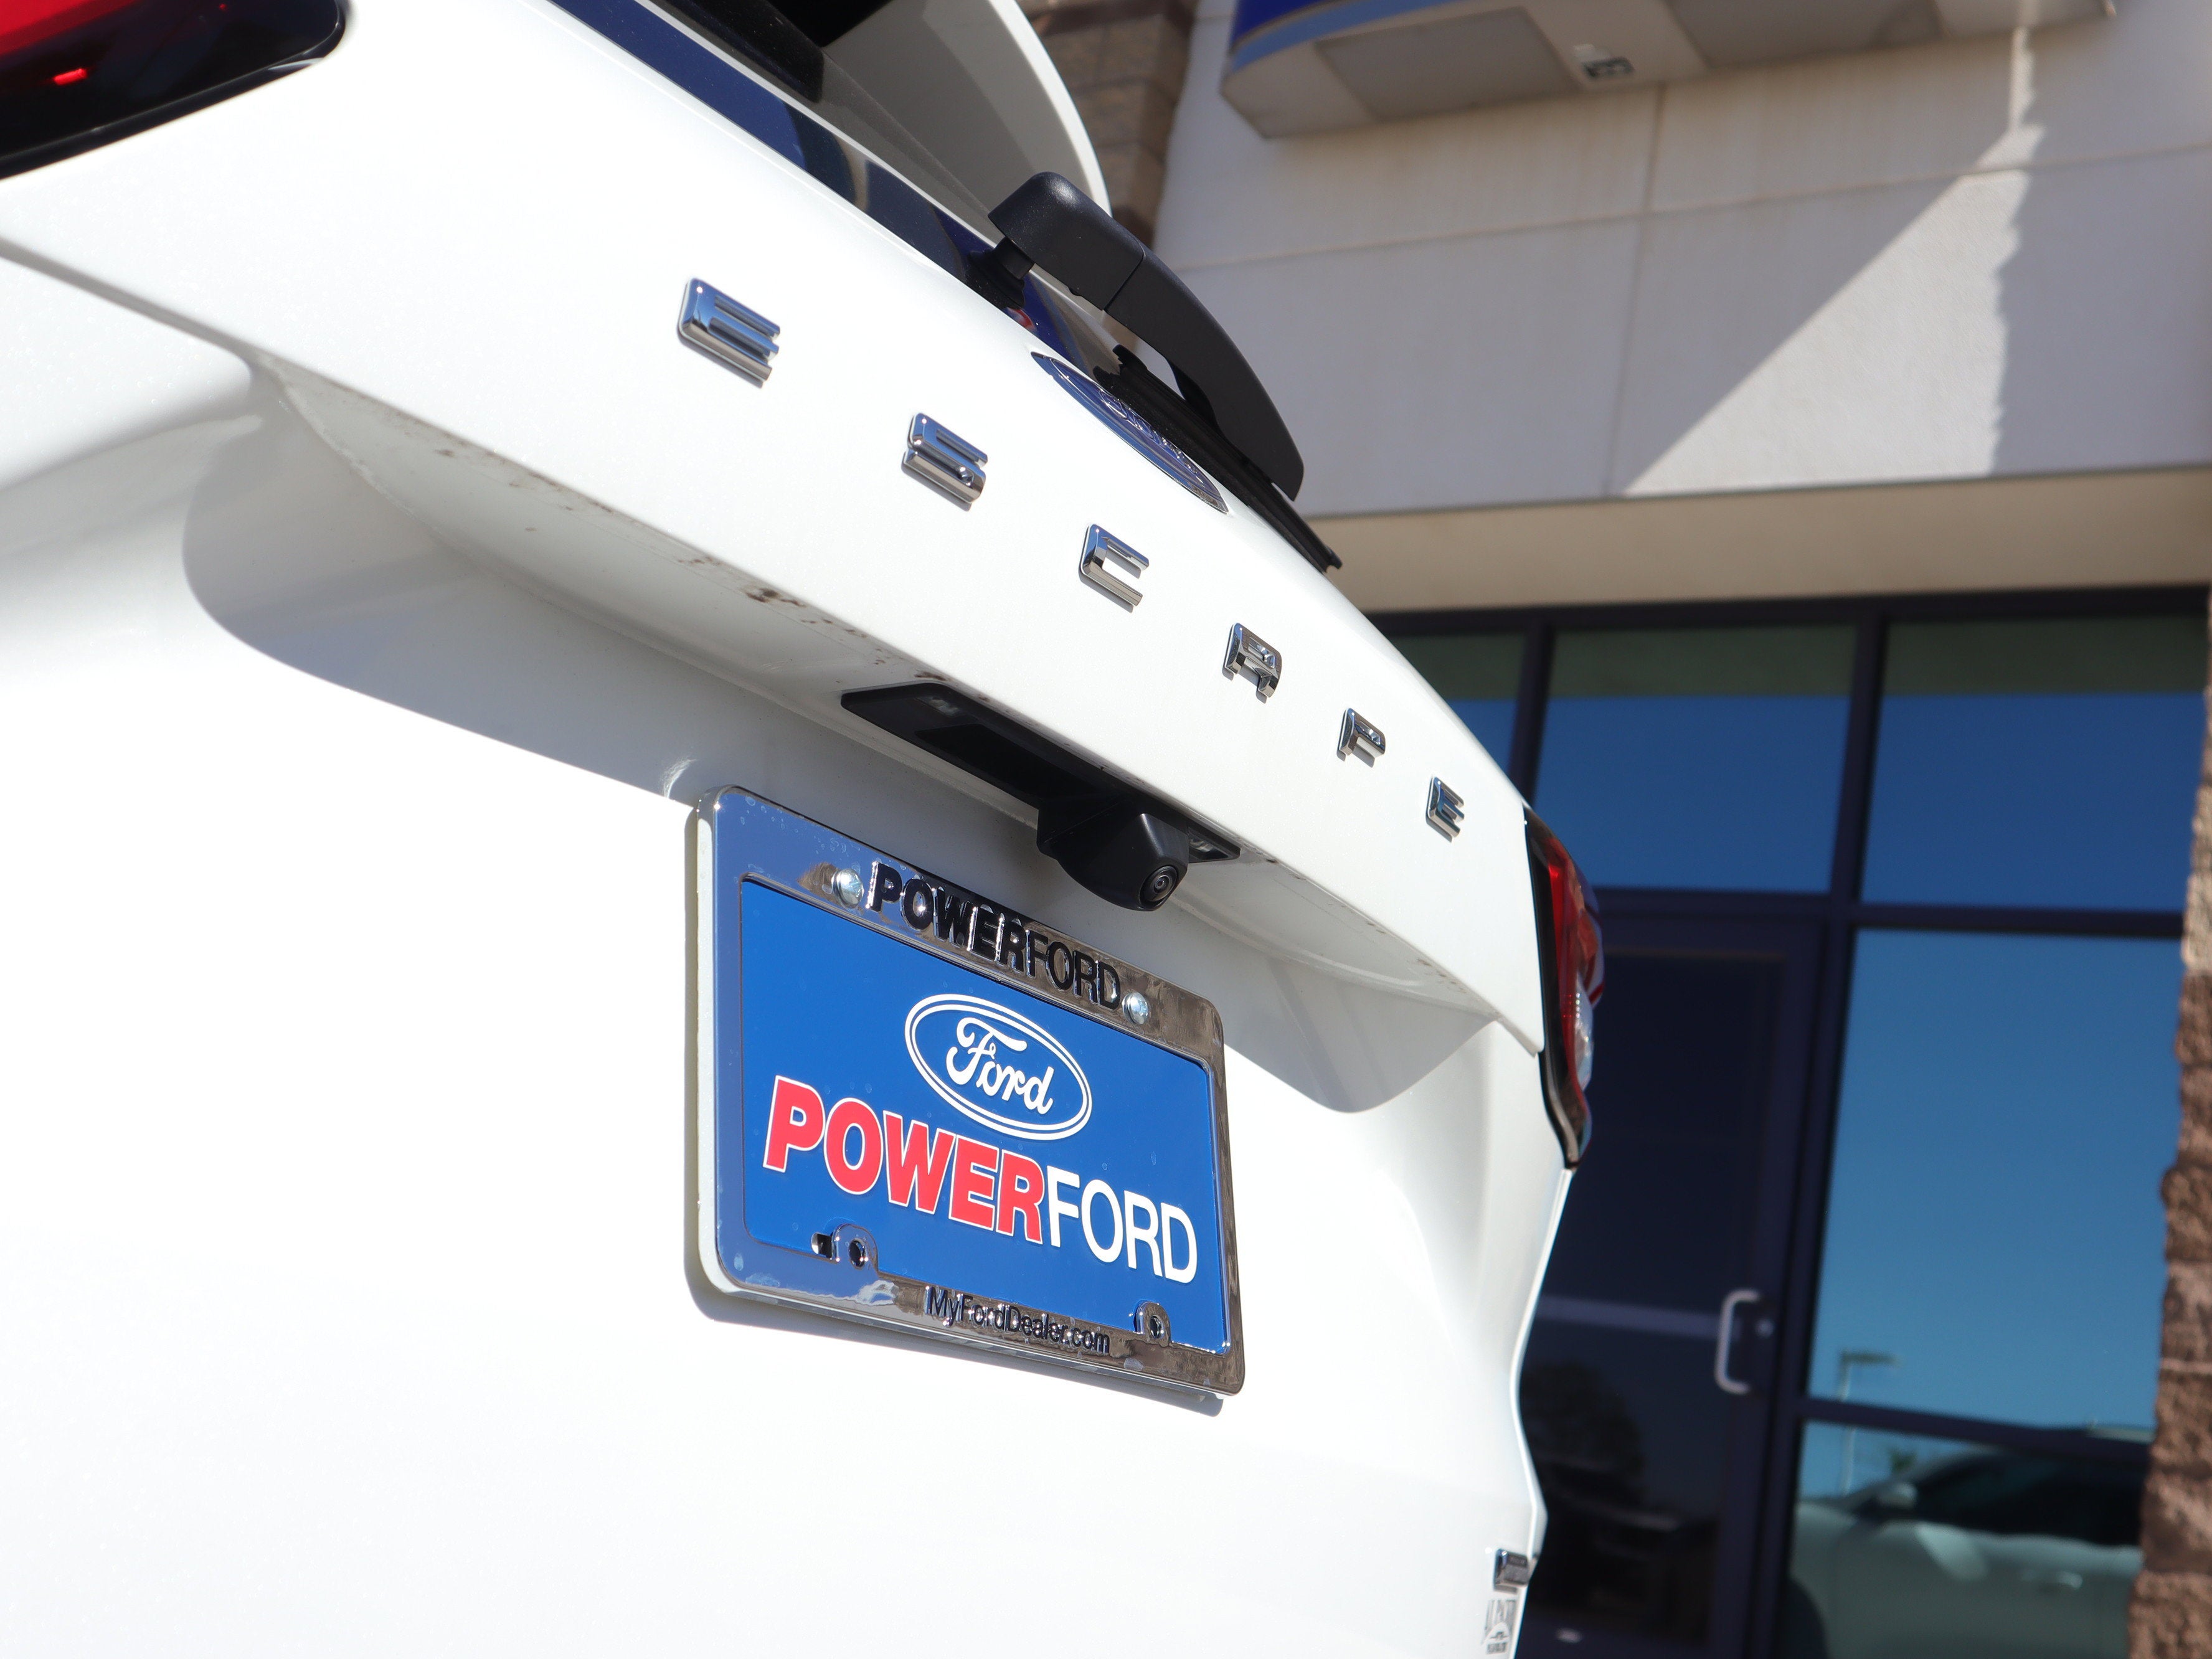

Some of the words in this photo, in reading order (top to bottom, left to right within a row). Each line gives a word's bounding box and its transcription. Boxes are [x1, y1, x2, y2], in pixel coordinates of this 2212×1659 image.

[679, 278, 1465, 838] ESCAPE
[946, 1017, 1054, 1115] Ford
[924, 1285, 1110, 1354] MyFordDealer.com
